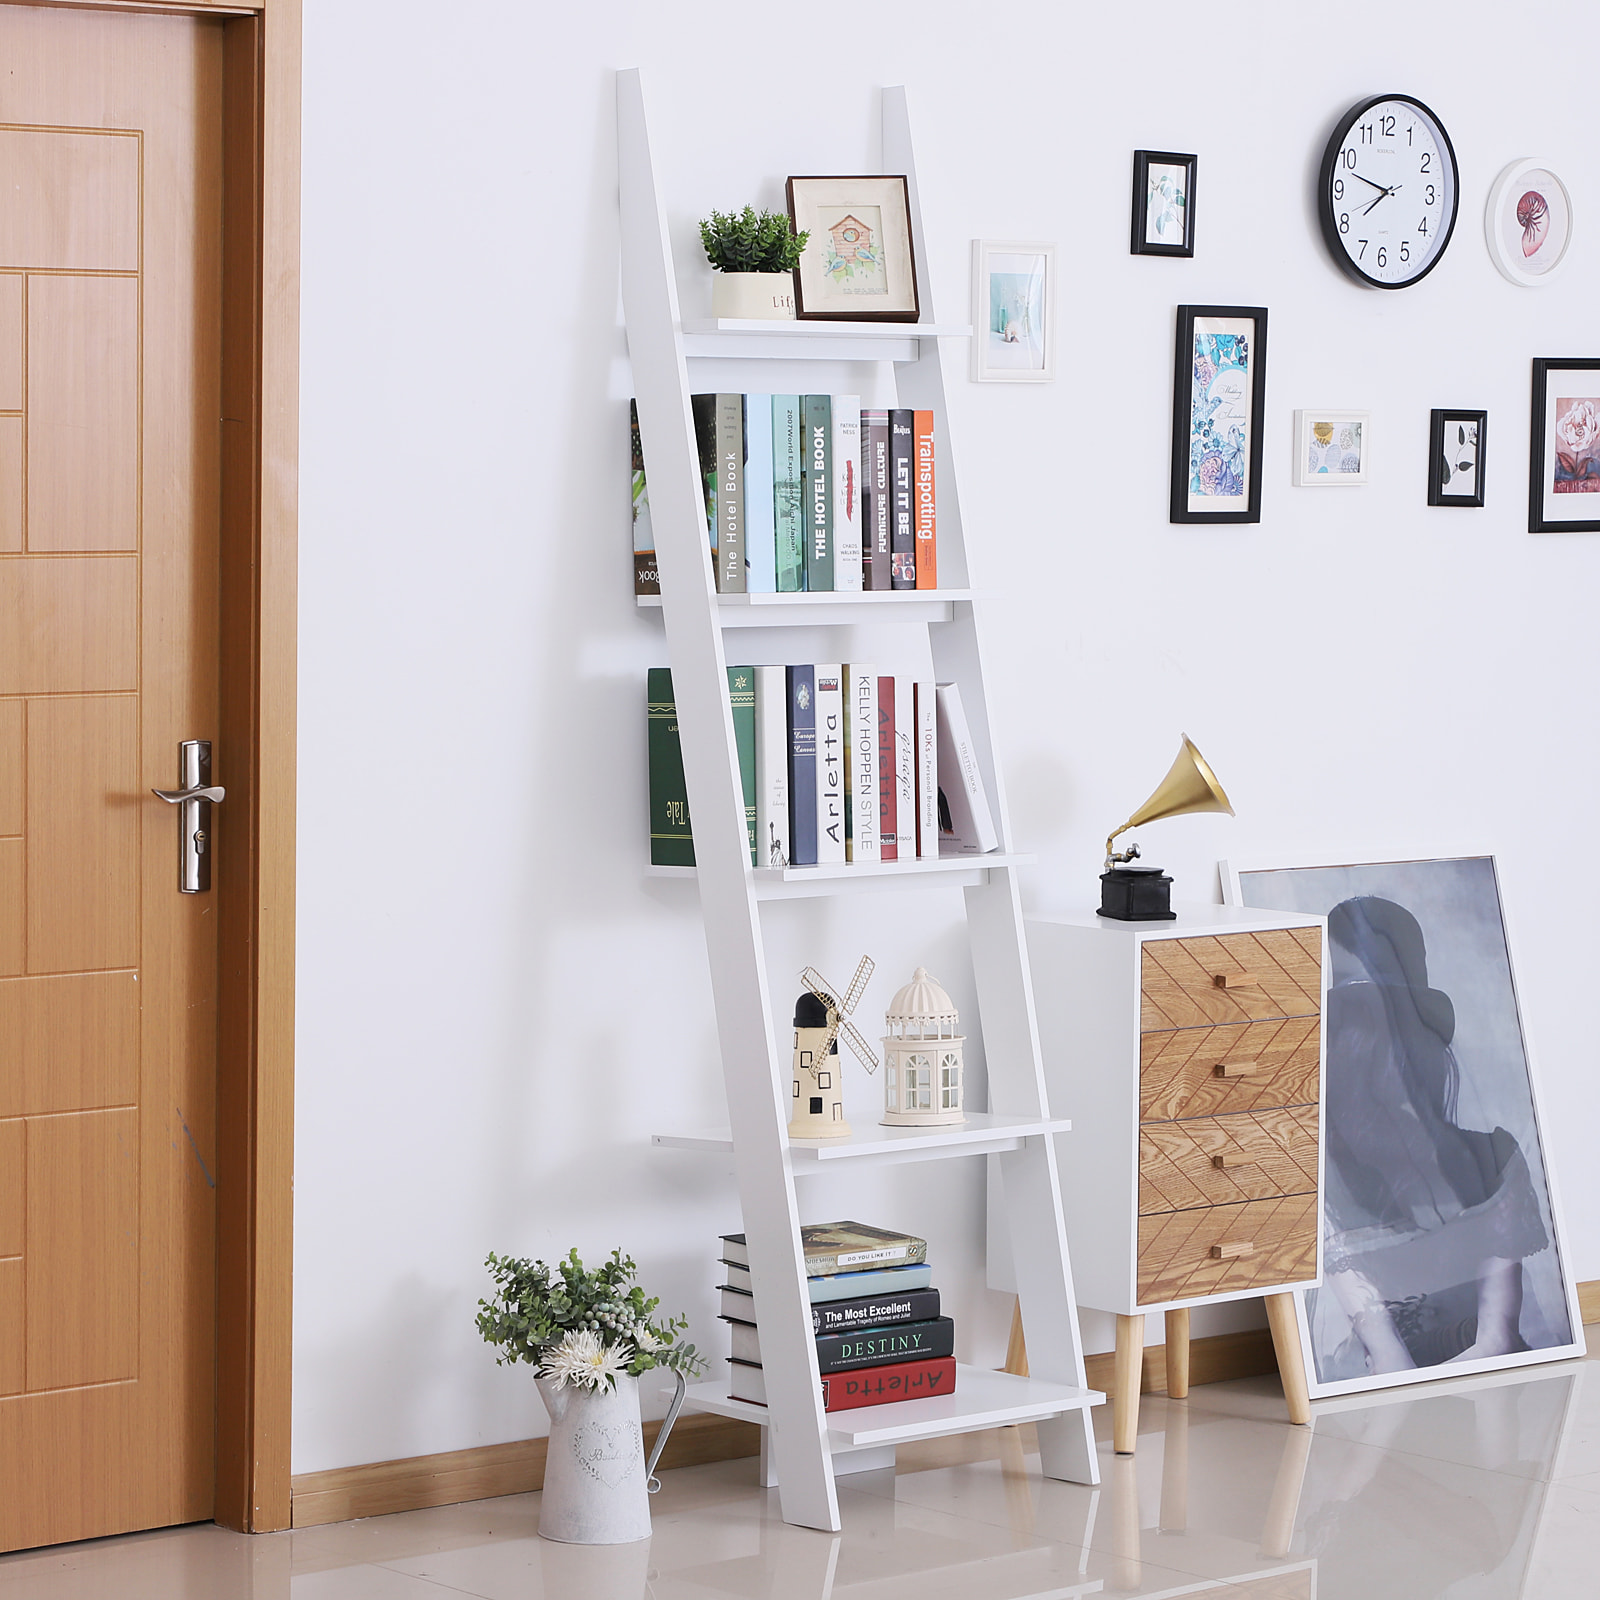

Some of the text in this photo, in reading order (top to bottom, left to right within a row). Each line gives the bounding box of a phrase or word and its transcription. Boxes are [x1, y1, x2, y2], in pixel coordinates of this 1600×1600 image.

[1360, 123, 1373, 144] 11
[1379, 115, 1396, 136] 12
[1406, 126, 1412, 146] 1
[1340, 148, 1357, 170] 10
[1420, 152, 1431, 174] 2
[1334, 179, 1345, 200] 9
[1425, 184, 1435, 205] 3
[1339, 213, 1350, 234] 8
[1417, 216, 1428, 237] 4
[1358, 240, 1369, 260] 7
[1377, 247, 1387, 268] 6
[1399, 241, 1410, 262] 5
[725, 452, 736, 491] Book
[813, 426, 827, 560] THE HOTEL BOOK
[876, 441, 887, 553] FURNITURE CULTURE
[897, 457, 910, 536] LET IT BE
[725, 500, 737, 543] Hotel
[726, 551, 738, 581] The
[858, 676, 873, 851] KELLY HOPPEN STYLE
[878, 708, 891, 816] Arletta
[823, 713, 840, 844] Arletta
[666, 800, 686, 825] Tale
[824, 1301, 912, 1323] The Most Excellent
[841, 1333, 922, 1359] DESTINY
[846, 1370, 944, 1397] Arletta
